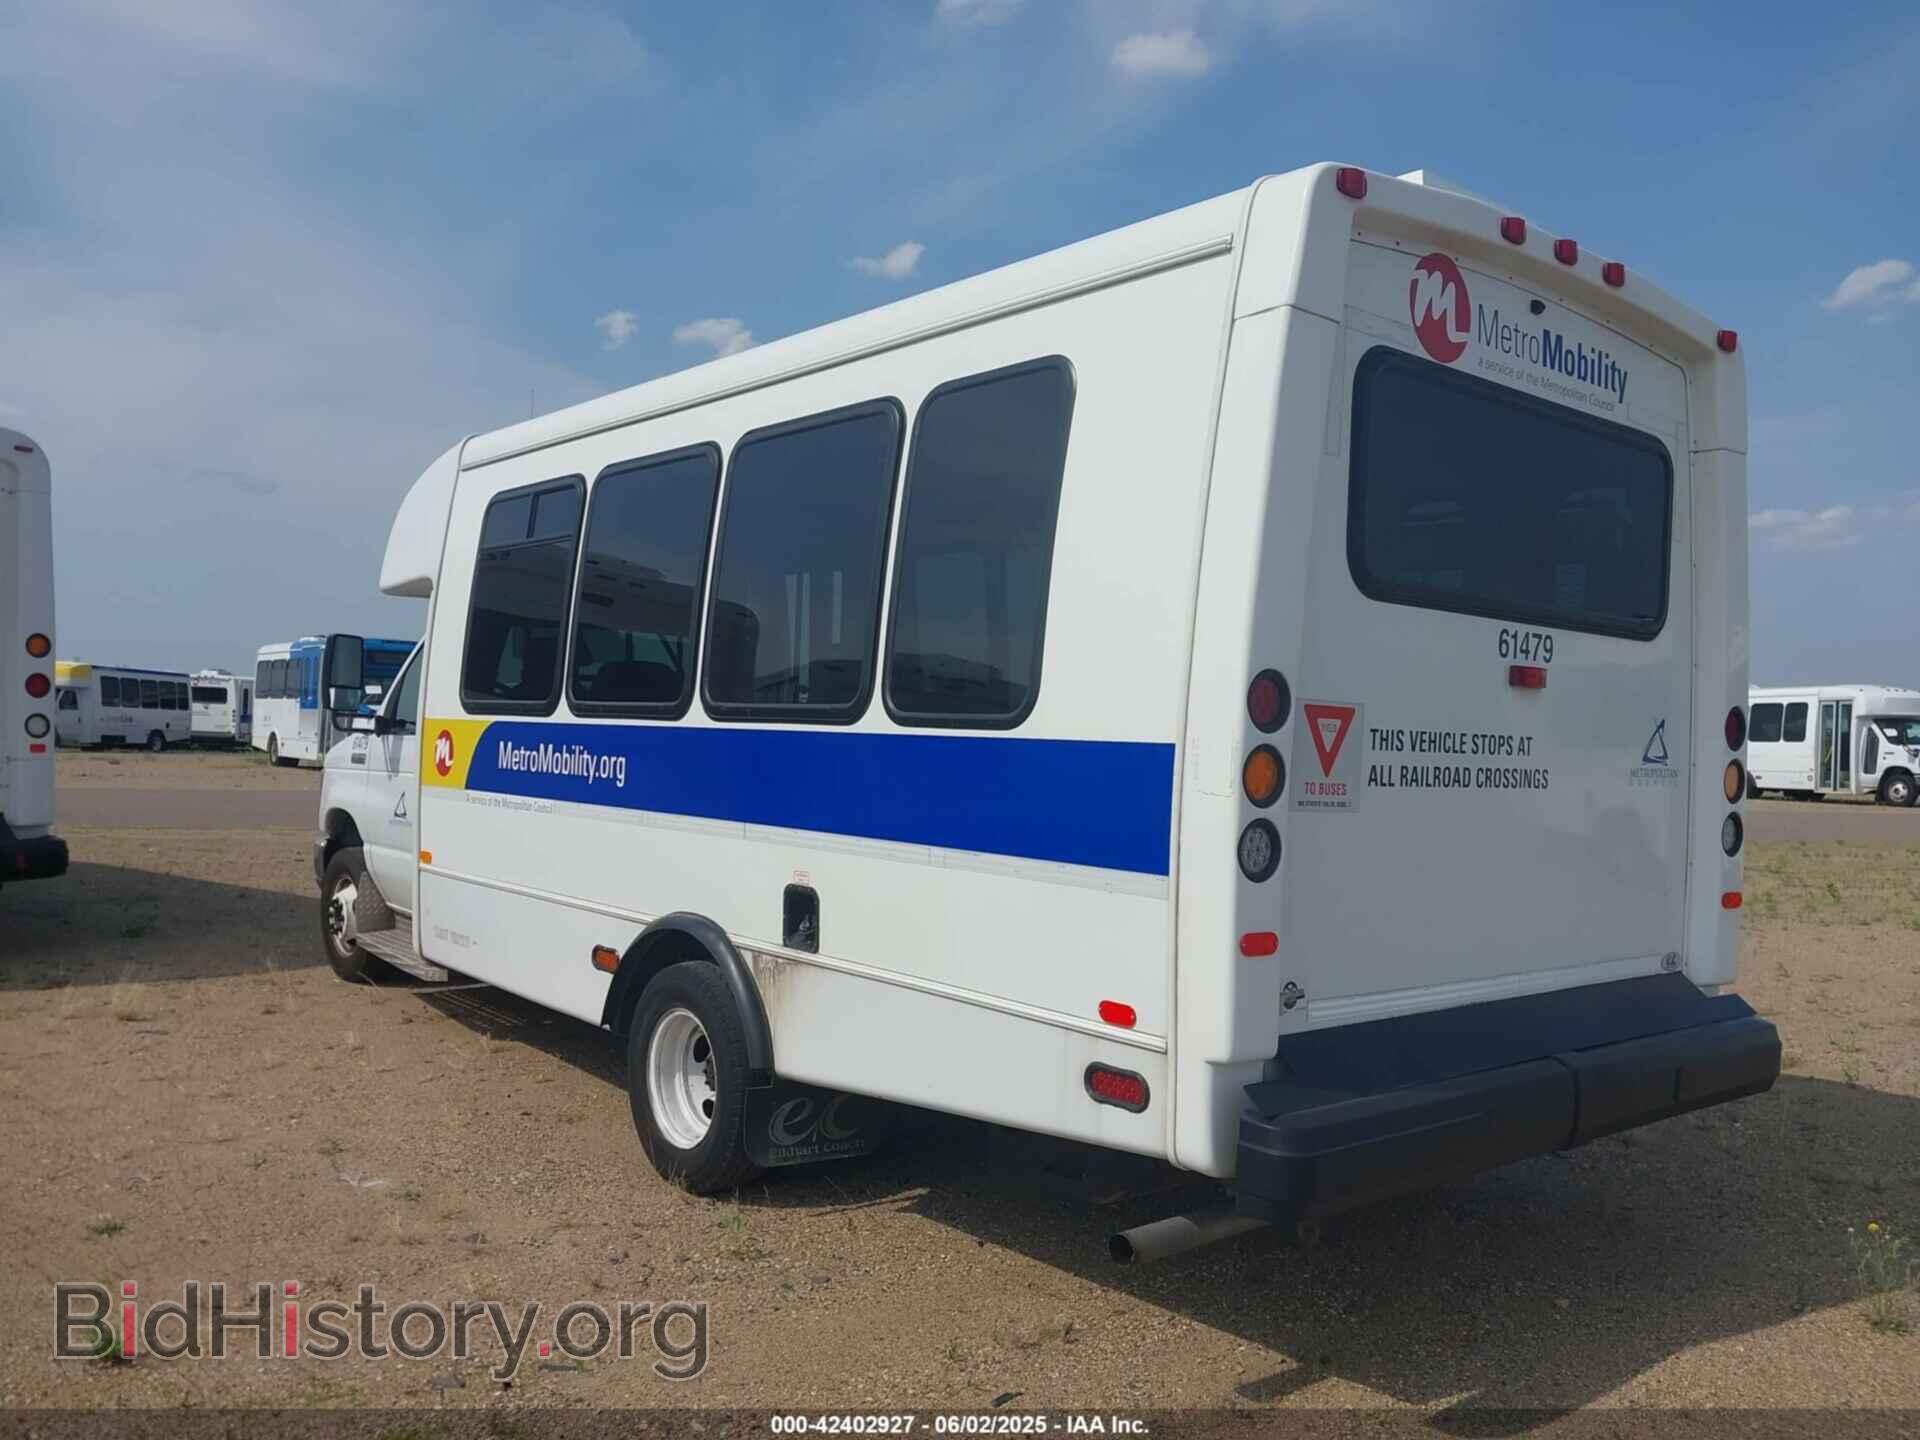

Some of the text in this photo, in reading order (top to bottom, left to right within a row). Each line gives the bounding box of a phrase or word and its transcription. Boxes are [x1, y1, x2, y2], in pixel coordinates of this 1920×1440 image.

[1478, 303, 1628, 404] MetroMobility
[1485, 359, 1514, 377] service
[1516, 368, 1525, 381] of
[1526, 371, 1539, 387] the
[1499, 628, 1554, 664] 61479
[1370, 728, 1533, 757] THIS VEHICLE STOPS AT
[498, 740, 626, 787] MetroMobility.org
[1368, 764, 1549, 790] ALL RAILROAD CROSSINGS
[1304, 782, 1347, 796] TO BUSES
